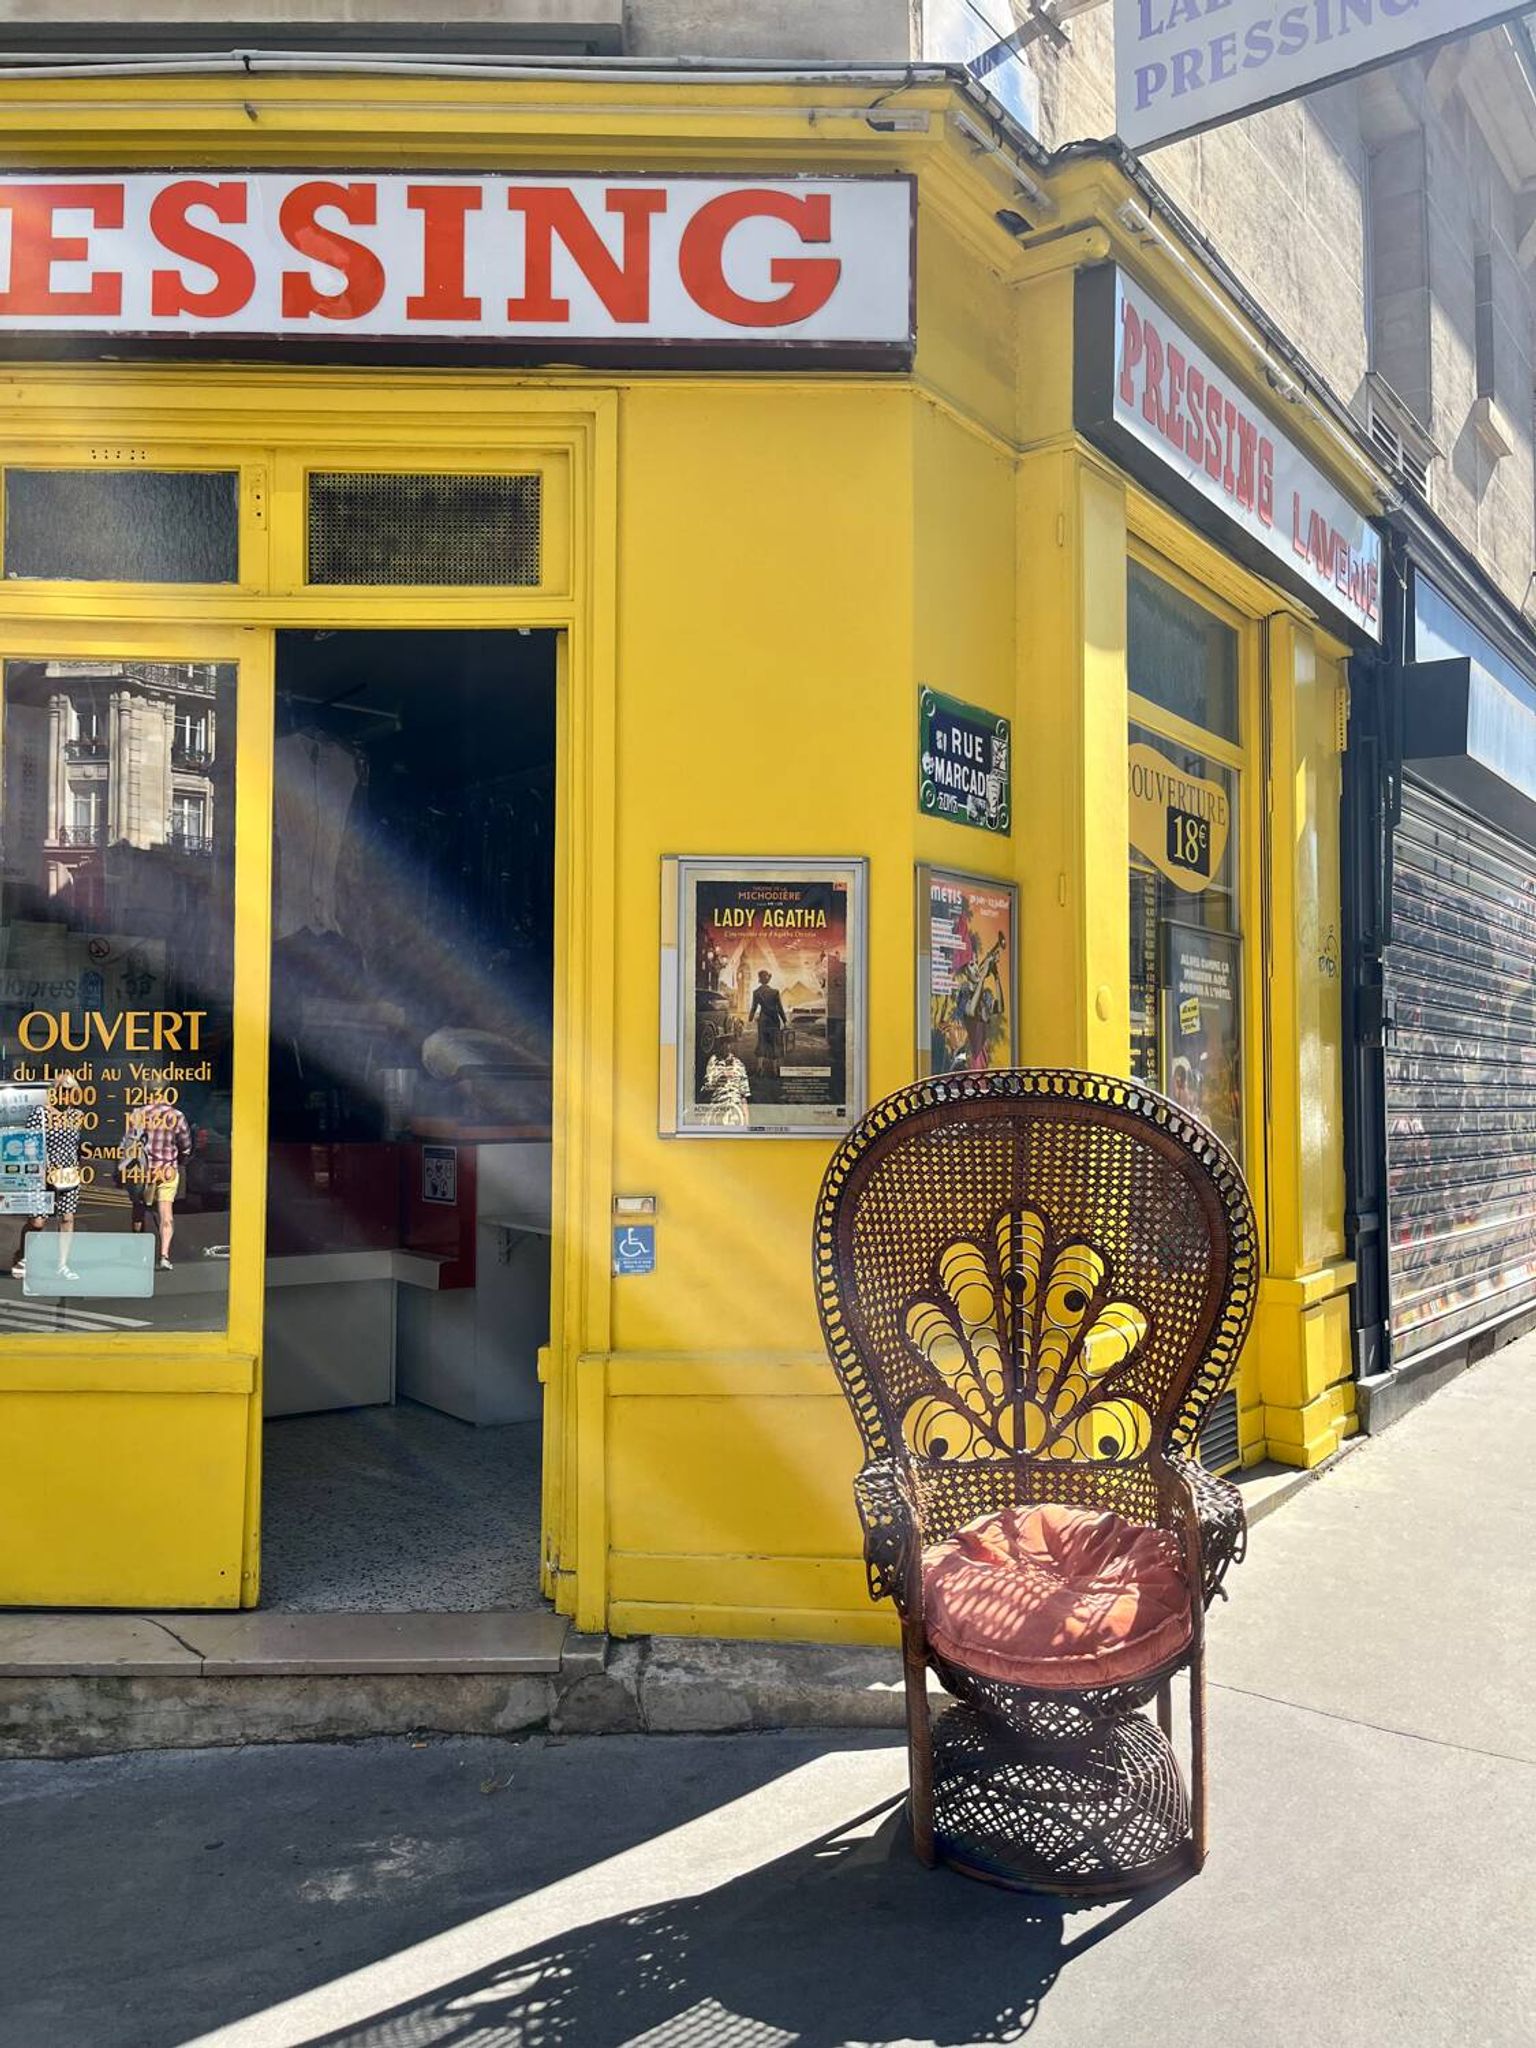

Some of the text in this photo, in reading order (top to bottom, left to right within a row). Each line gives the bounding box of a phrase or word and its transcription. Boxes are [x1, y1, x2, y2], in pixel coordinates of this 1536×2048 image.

[1119, 298, 1275, 529] PRESSING
[951, 727, 984, 764] RUE
[934, 756, 992, 797] MARCAD
[1128, 762, 1226, 826] OUVERTURE
[1174, 815, 1207, 864] 18€
[738, 890, 800, 900] MICHODIÈRE
[714, 908, 827, 928] LADY AGATHA
[18, 1011, 207, 1052] OUVERT
[13, 1061, 36, 1081] du
[43, 1061, 93, 1081] Lundi
[129, 1061, 212, 1081] Vendredi
